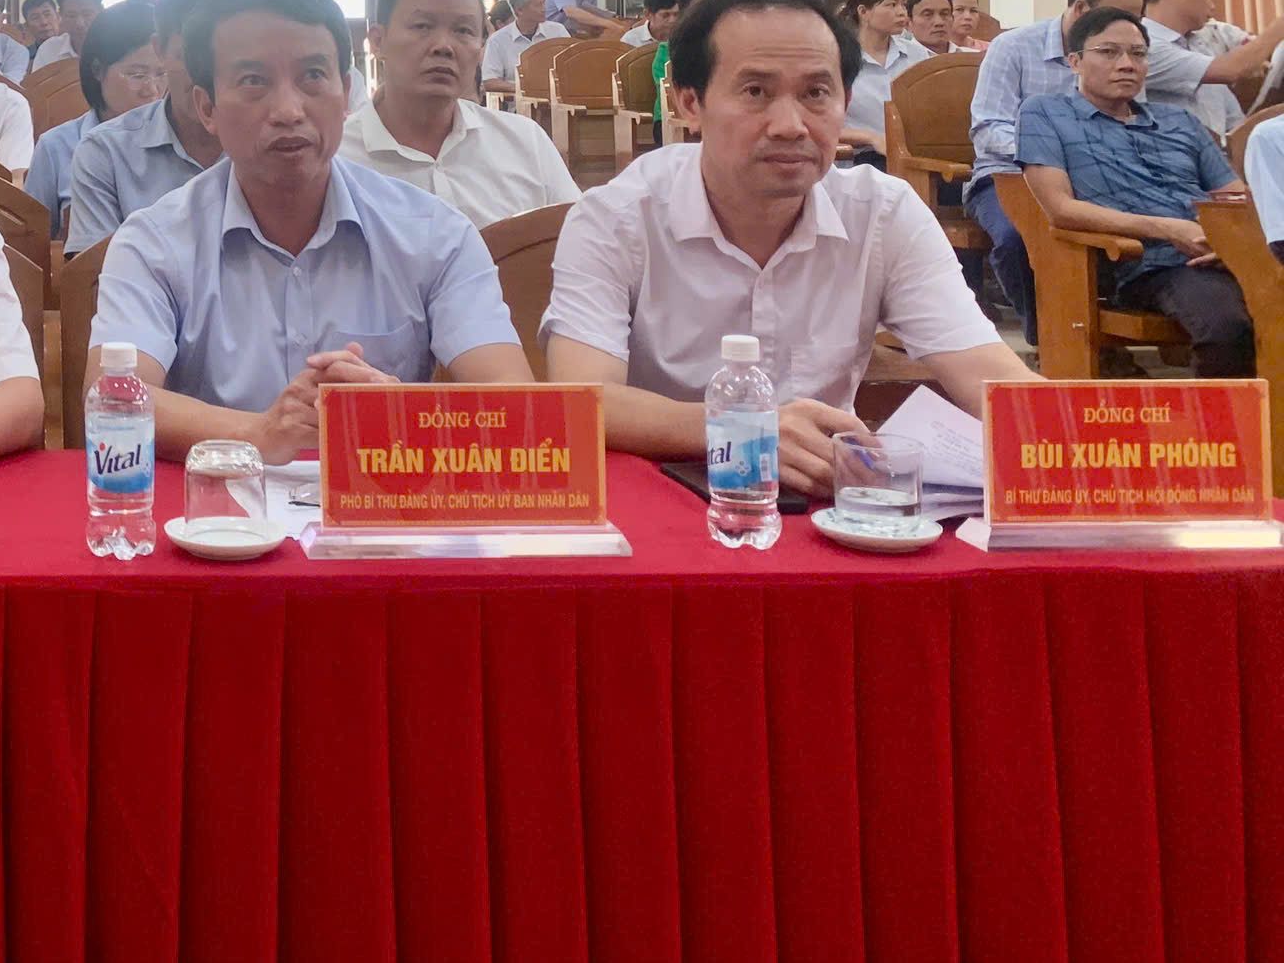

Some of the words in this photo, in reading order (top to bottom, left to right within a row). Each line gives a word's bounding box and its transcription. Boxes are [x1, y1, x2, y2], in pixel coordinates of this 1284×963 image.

[418, 404, 471, 429] ĐỒNG
[475, 407, 507, 428] CHÍ
[1083, 400, 1135, 424] ĐỒNG
[1140, 401, 1171, 423] CHÍ
[94, 444, 142, 475] Vital
[357, 439, 425, 473] TRẦN
[432, 443, 502, 473] XUÂN
[1020, 439, 1063, 468] BÙI
[1071, 438, 1141, 468] XUÂN
